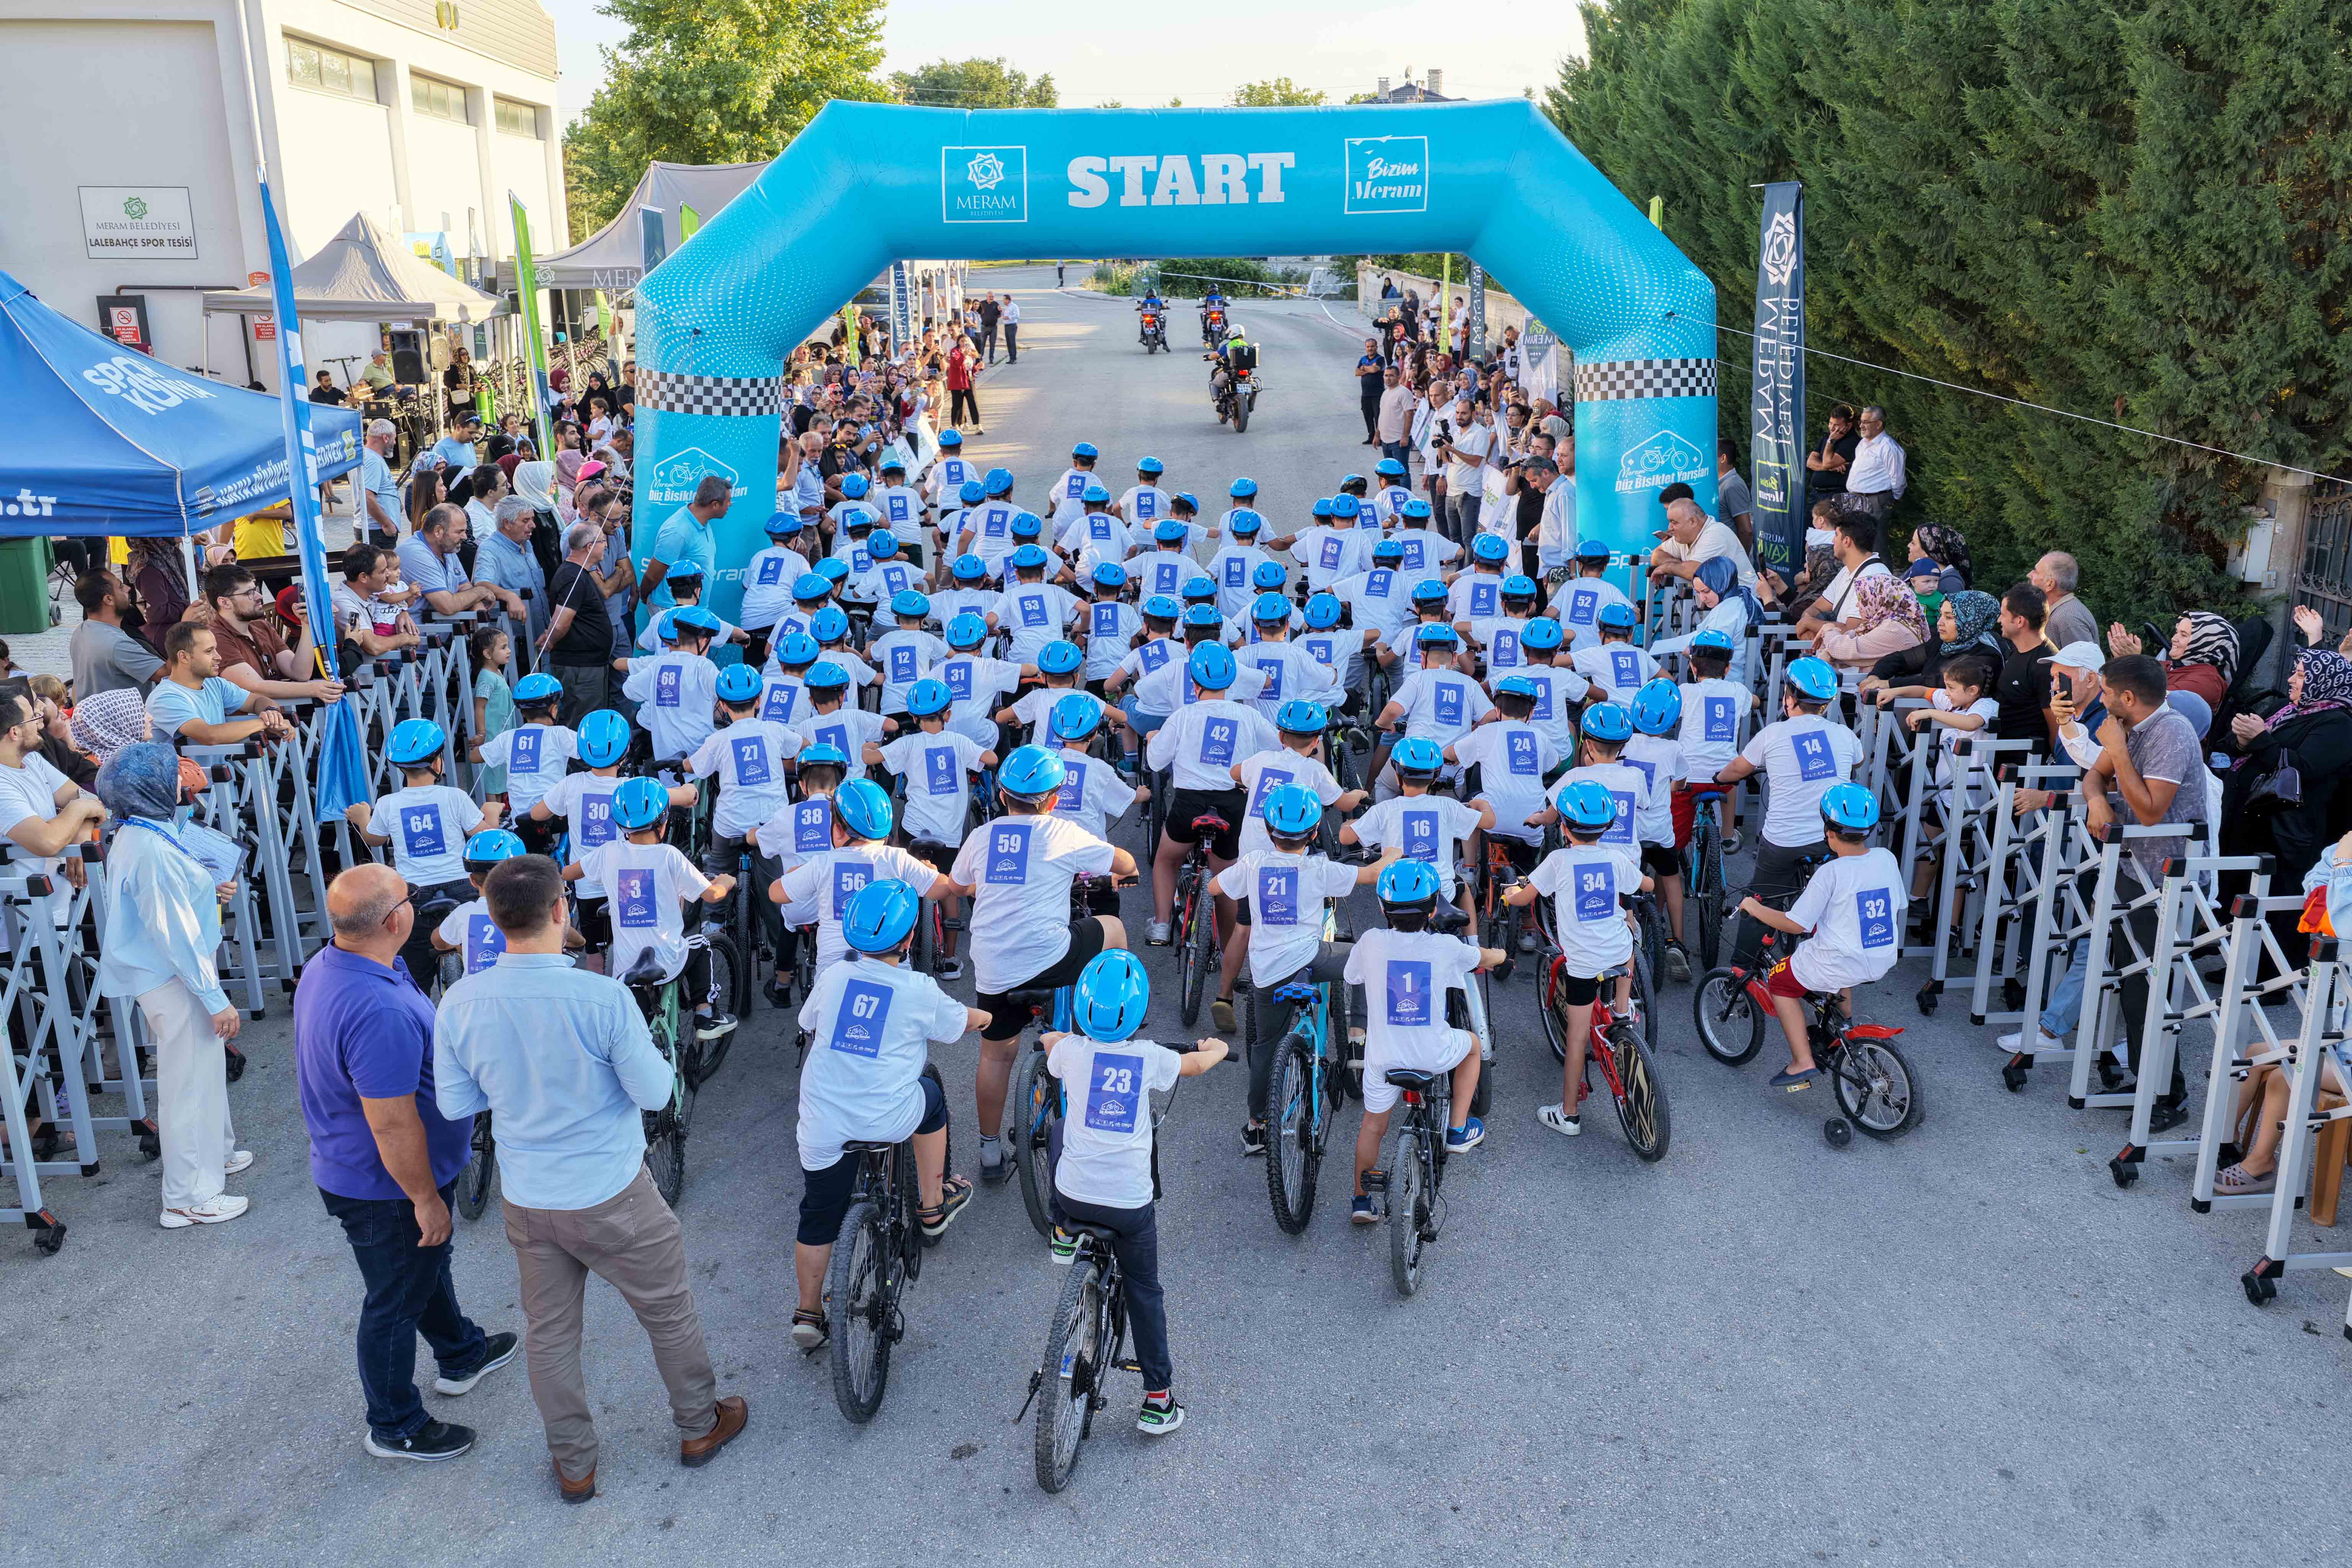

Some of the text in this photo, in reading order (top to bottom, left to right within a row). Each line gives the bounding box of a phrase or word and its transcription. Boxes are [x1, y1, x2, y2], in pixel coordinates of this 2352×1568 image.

[1367, 157, 1419, 179] Bizim
[1067, 152, 1295, 208] START
[1352, 181, 1422, 199] Meram
[956, 195, 1017, 209] MERAM
[96, 221, 180, 230] MERAM BELEDİYESİ
[89, 236, 193, 248] LALEBAHÇE SPOR TESİSİ
[591, 269, 637, 287] MER
[83, 356, 165, 394] SPOR
[120, 376, 218, 416] KONYA
[1615, 467, 1709, 492] Düz Bisiklet Yarışları
[1617, 468, 1646, 481] Meram
[0, 488, 57, 516] .tr
[648, 490, 663, 501] Düz
[1140, 497, 1151, 505] 35
[893, 499, 903, 508] 50
[992, 514, 1002, 522] 18
[1361, 508, 1373, 516] 36
[1325, 543, 1338, 554] 43
[1406, 544, 1418, 554] 33
[856, 552, 868, 560] 69
[768, 561, 775, 570] 6
[1230, 562, 1240, 572] 10
[890, 572, 902, 582] 48
[1163, 569, 1170, 578] 4
[1373, 574, 1385, 582] 41
[1480, 589, 1486, 598] 5
[1024, 600, 1039, 610] 53
[1578, 596, 1591, 607] 52
[1101, 609, 1111, 619] 71
[1500, 636, 1512, 648] 19
[1147, 645, 1160, 656] 74
[1312, 647, 1326, 658] 75
[897, 652, 909, 664] 12
[1618, 657, 1631, 668] 57
[662, 673, 675, 685] 68
[951, 668, 964, 681] 31
[772, 691, 789, 703] 65
[1442, 689, 1456, 702] 70
[1715, 704, 1724, 718] 9
[1211, 726, 1229, 742] 42
[519, 736, 533, 750] 61
[1514, 738, 1531, 751] 24
[1802, 739, 1822, 755] 14
[742, 745, 758, 761] 27
[937, 755, 946, 770] 8
[589, 803, 609, 820] 30
[802, 808, 822, 825] 38
[410, 814, 433, 832] 64
[1411, 820, 1429, 836] 16
[998, 835, 1021, 853] 59
[842, 873, 864, 891] 56
[1268, 877, 1285, 895] 21
[1583, 872, 1606, 892] 34
[630, 880, 641, 898] 3
[1865, 899, 1885, 918] 32
[483, 925, 494, 943] 2
[1403, 972, 1411, 992] 1
[853, 994, 879, 1018] 67
[1102, 1068, 1132, 1093] 23
[1140, 1414, 1158, 1423] adidas
